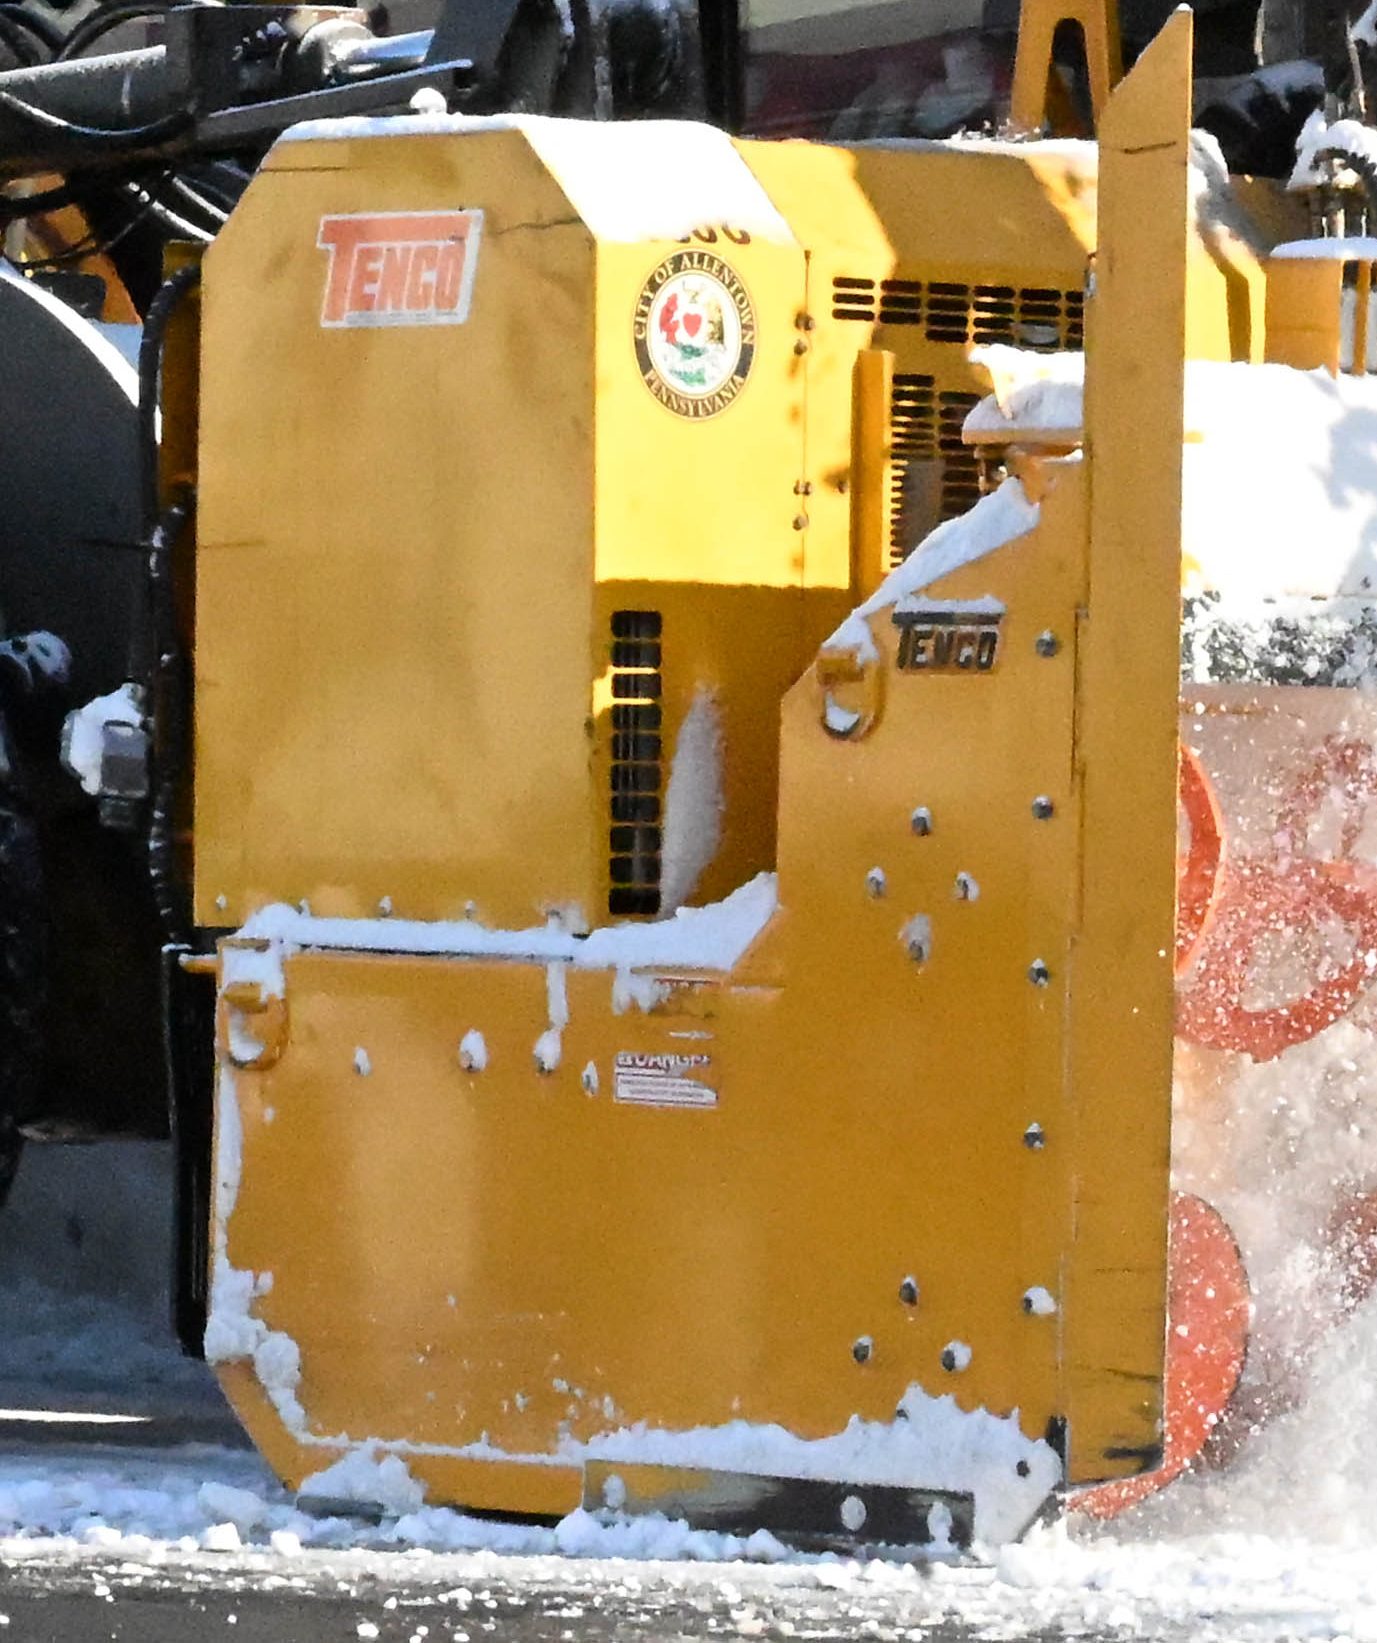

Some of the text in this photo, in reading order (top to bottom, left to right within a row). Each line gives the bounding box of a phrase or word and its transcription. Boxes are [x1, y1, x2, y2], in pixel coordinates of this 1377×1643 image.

[322, 214, 472, 323] TENCO
[634, 252, 756, 345] CITY OF ALLENTOWN
[643, 369, 745, 418] PENNSYLVANIA
[891, 610, 1002, 671] TENCO
